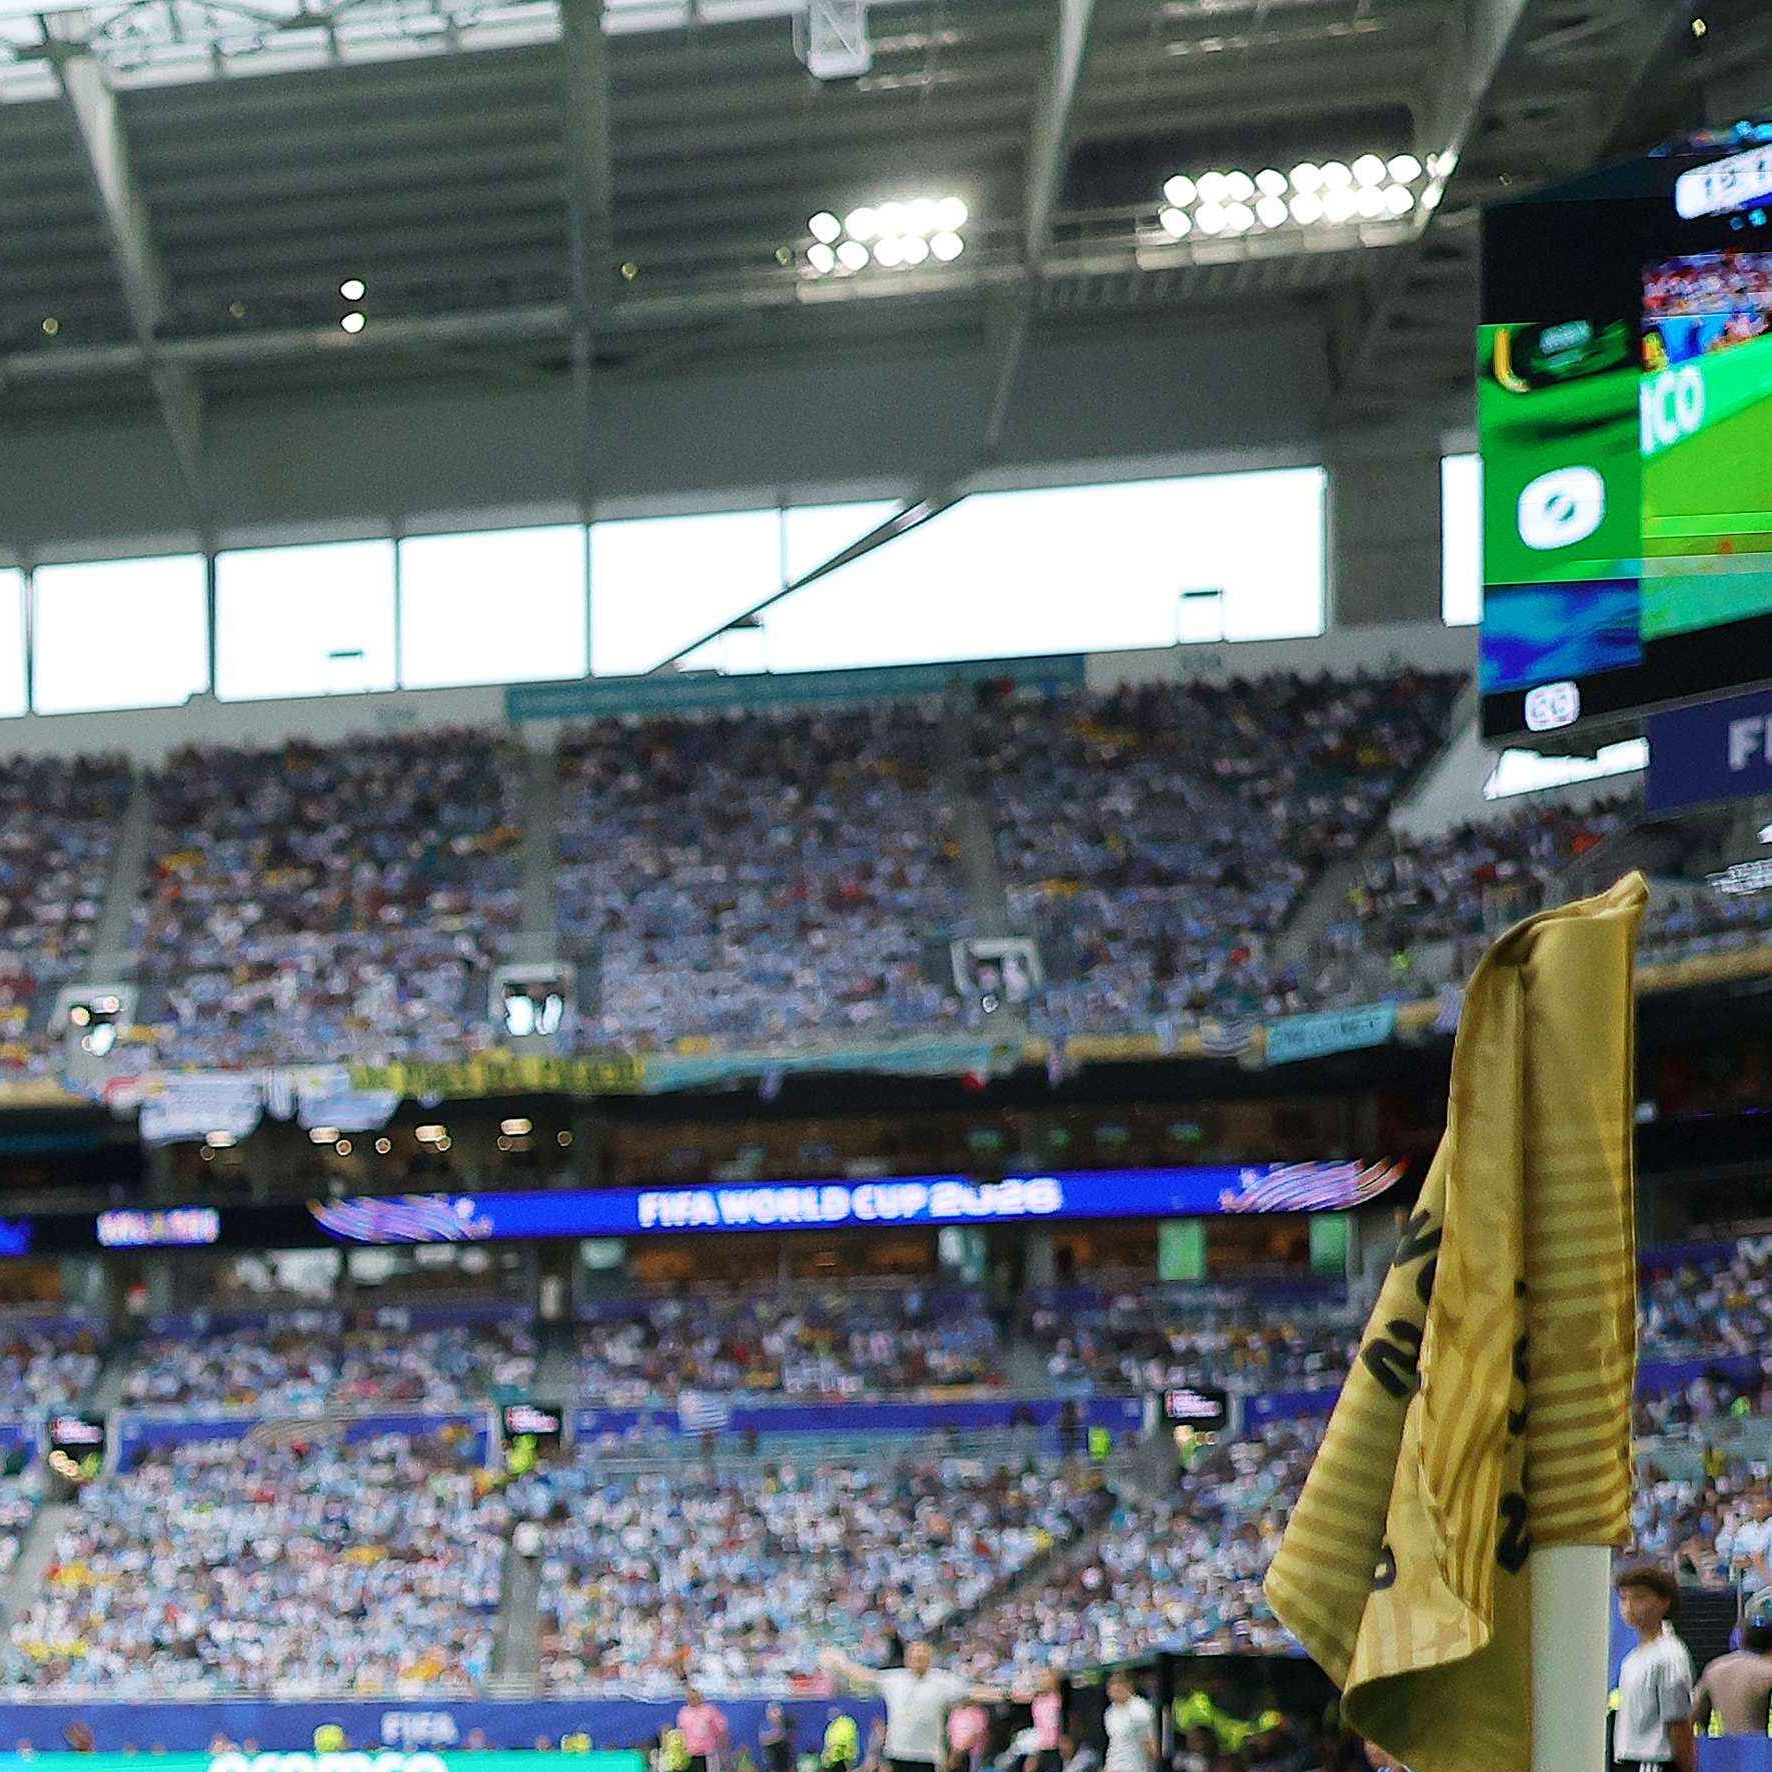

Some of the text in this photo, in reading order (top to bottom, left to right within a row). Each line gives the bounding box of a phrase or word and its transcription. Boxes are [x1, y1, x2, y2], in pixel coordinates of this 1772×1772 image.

[637, 1190, 719, 1227] FIFA
[717, 1186, 850, 1225] WORLD
[851, 1183, 927, 1221] CUP
